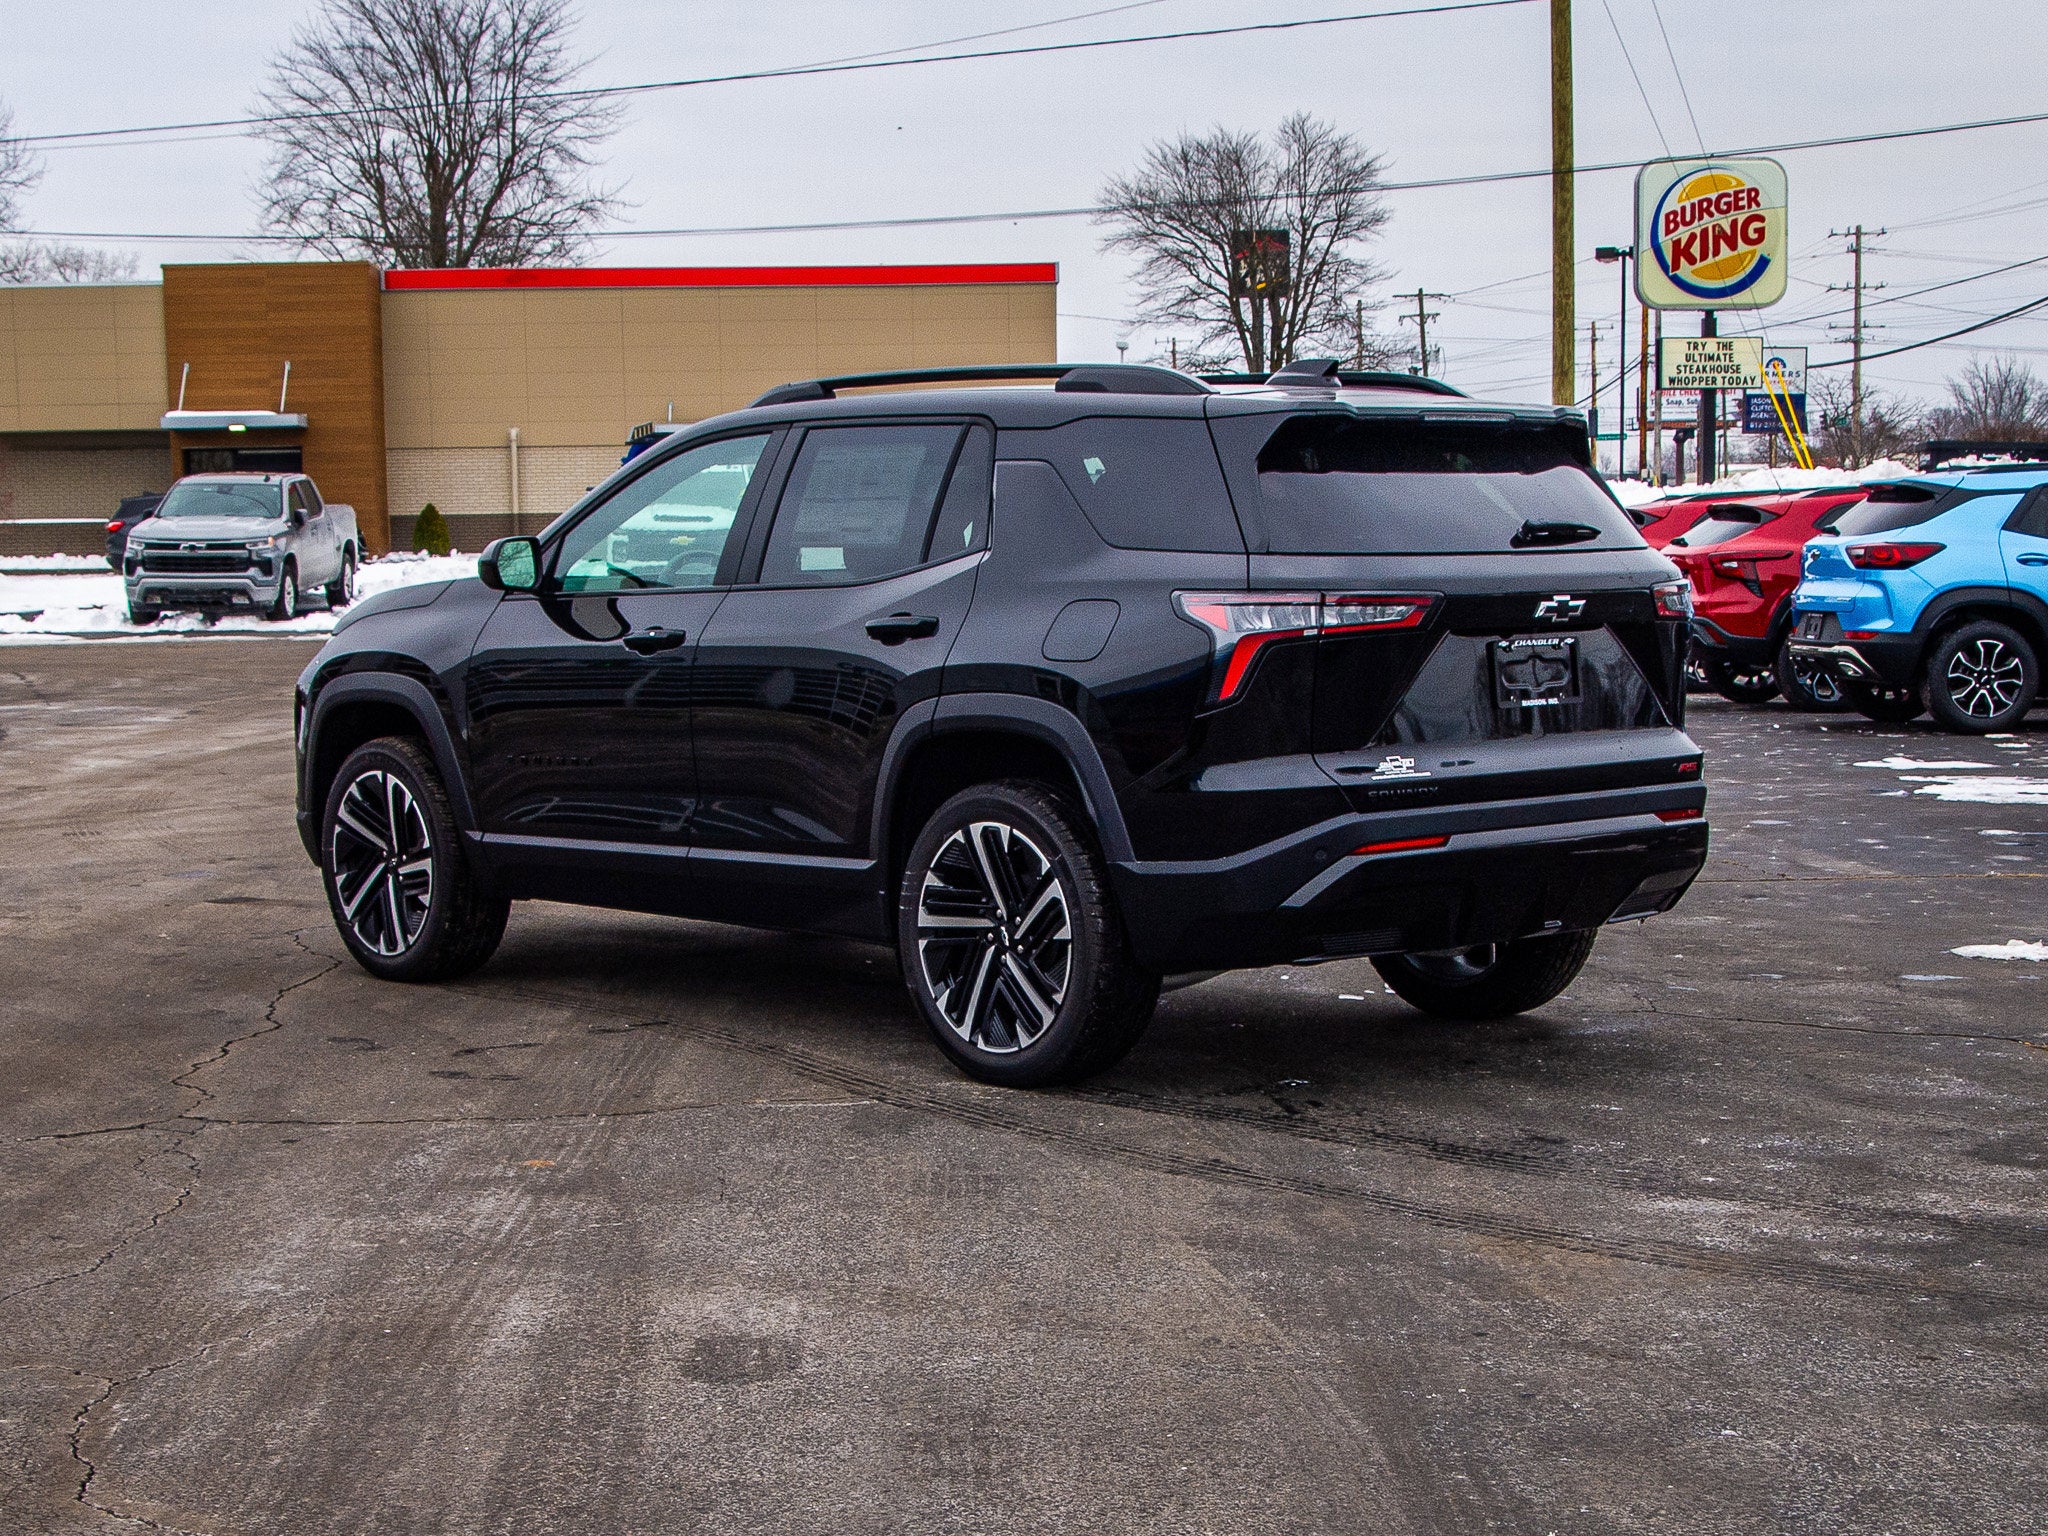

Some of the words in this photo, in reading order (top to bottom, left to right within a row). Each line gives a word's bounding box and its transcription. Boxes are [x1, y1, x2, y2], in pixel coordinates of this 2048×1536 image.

[1664, 187, 1761, 238] BURGER
[1670, 213, 1766, 273] KING
[1686, 341, 1707, 351] TRY
[1716, 341, 1734, 351] THE
[1685, 353, 1734, 363] ULTIMATE
[1676, 364, 1741, 374] STEAKHOUSE
[1668, 376, 1717, 386] WHOPPER
[1721, 376, 1756, 386] TODAY
[1514, 638, 1560, 647] CHANDLER
